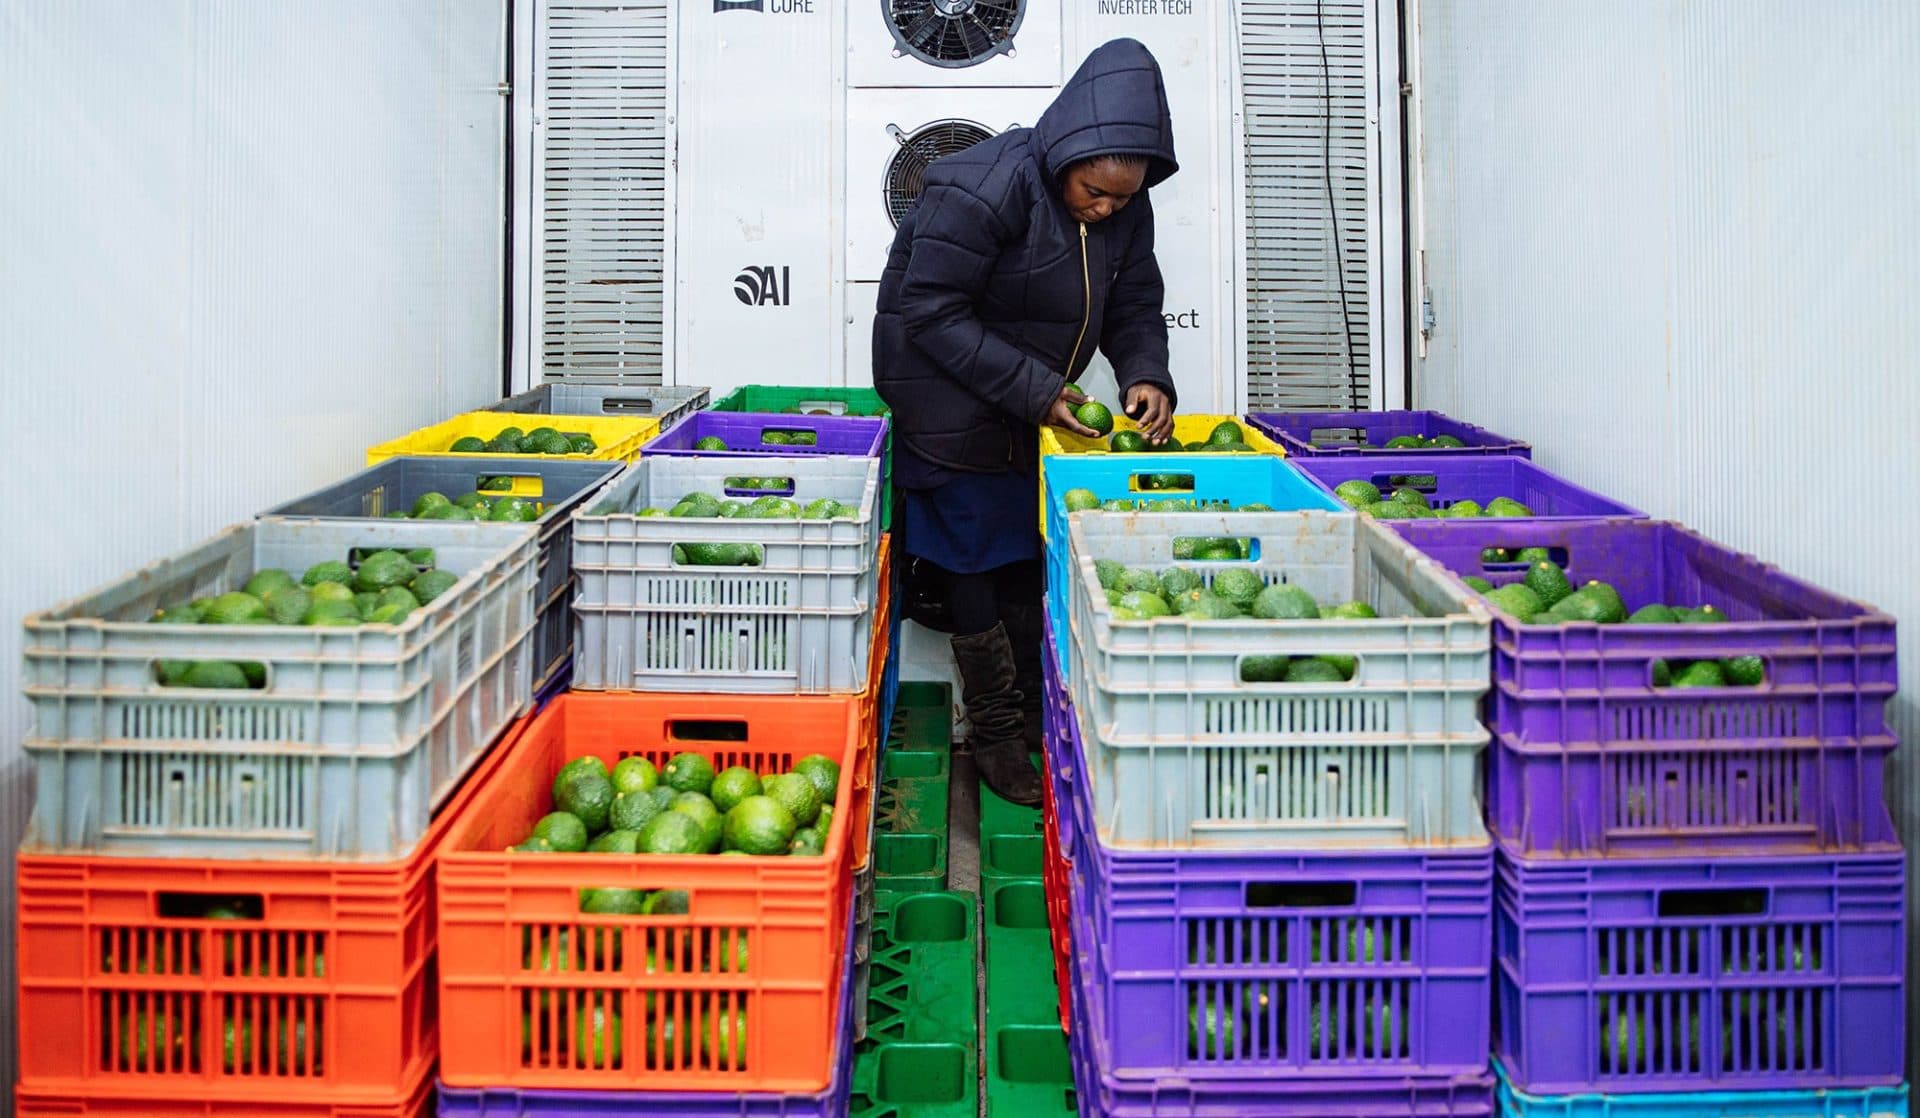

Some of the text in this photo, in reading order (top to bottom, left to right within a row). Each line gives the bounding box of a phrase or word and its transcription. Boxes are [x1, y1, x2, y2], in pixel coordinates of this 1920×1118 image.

[771, 0, 814, 13] CORE
[1098, 0, 1192, 14] INVERTER TECH
[759, 266, 789, 306] AI
[1164, 309, 1200, 328] ect
